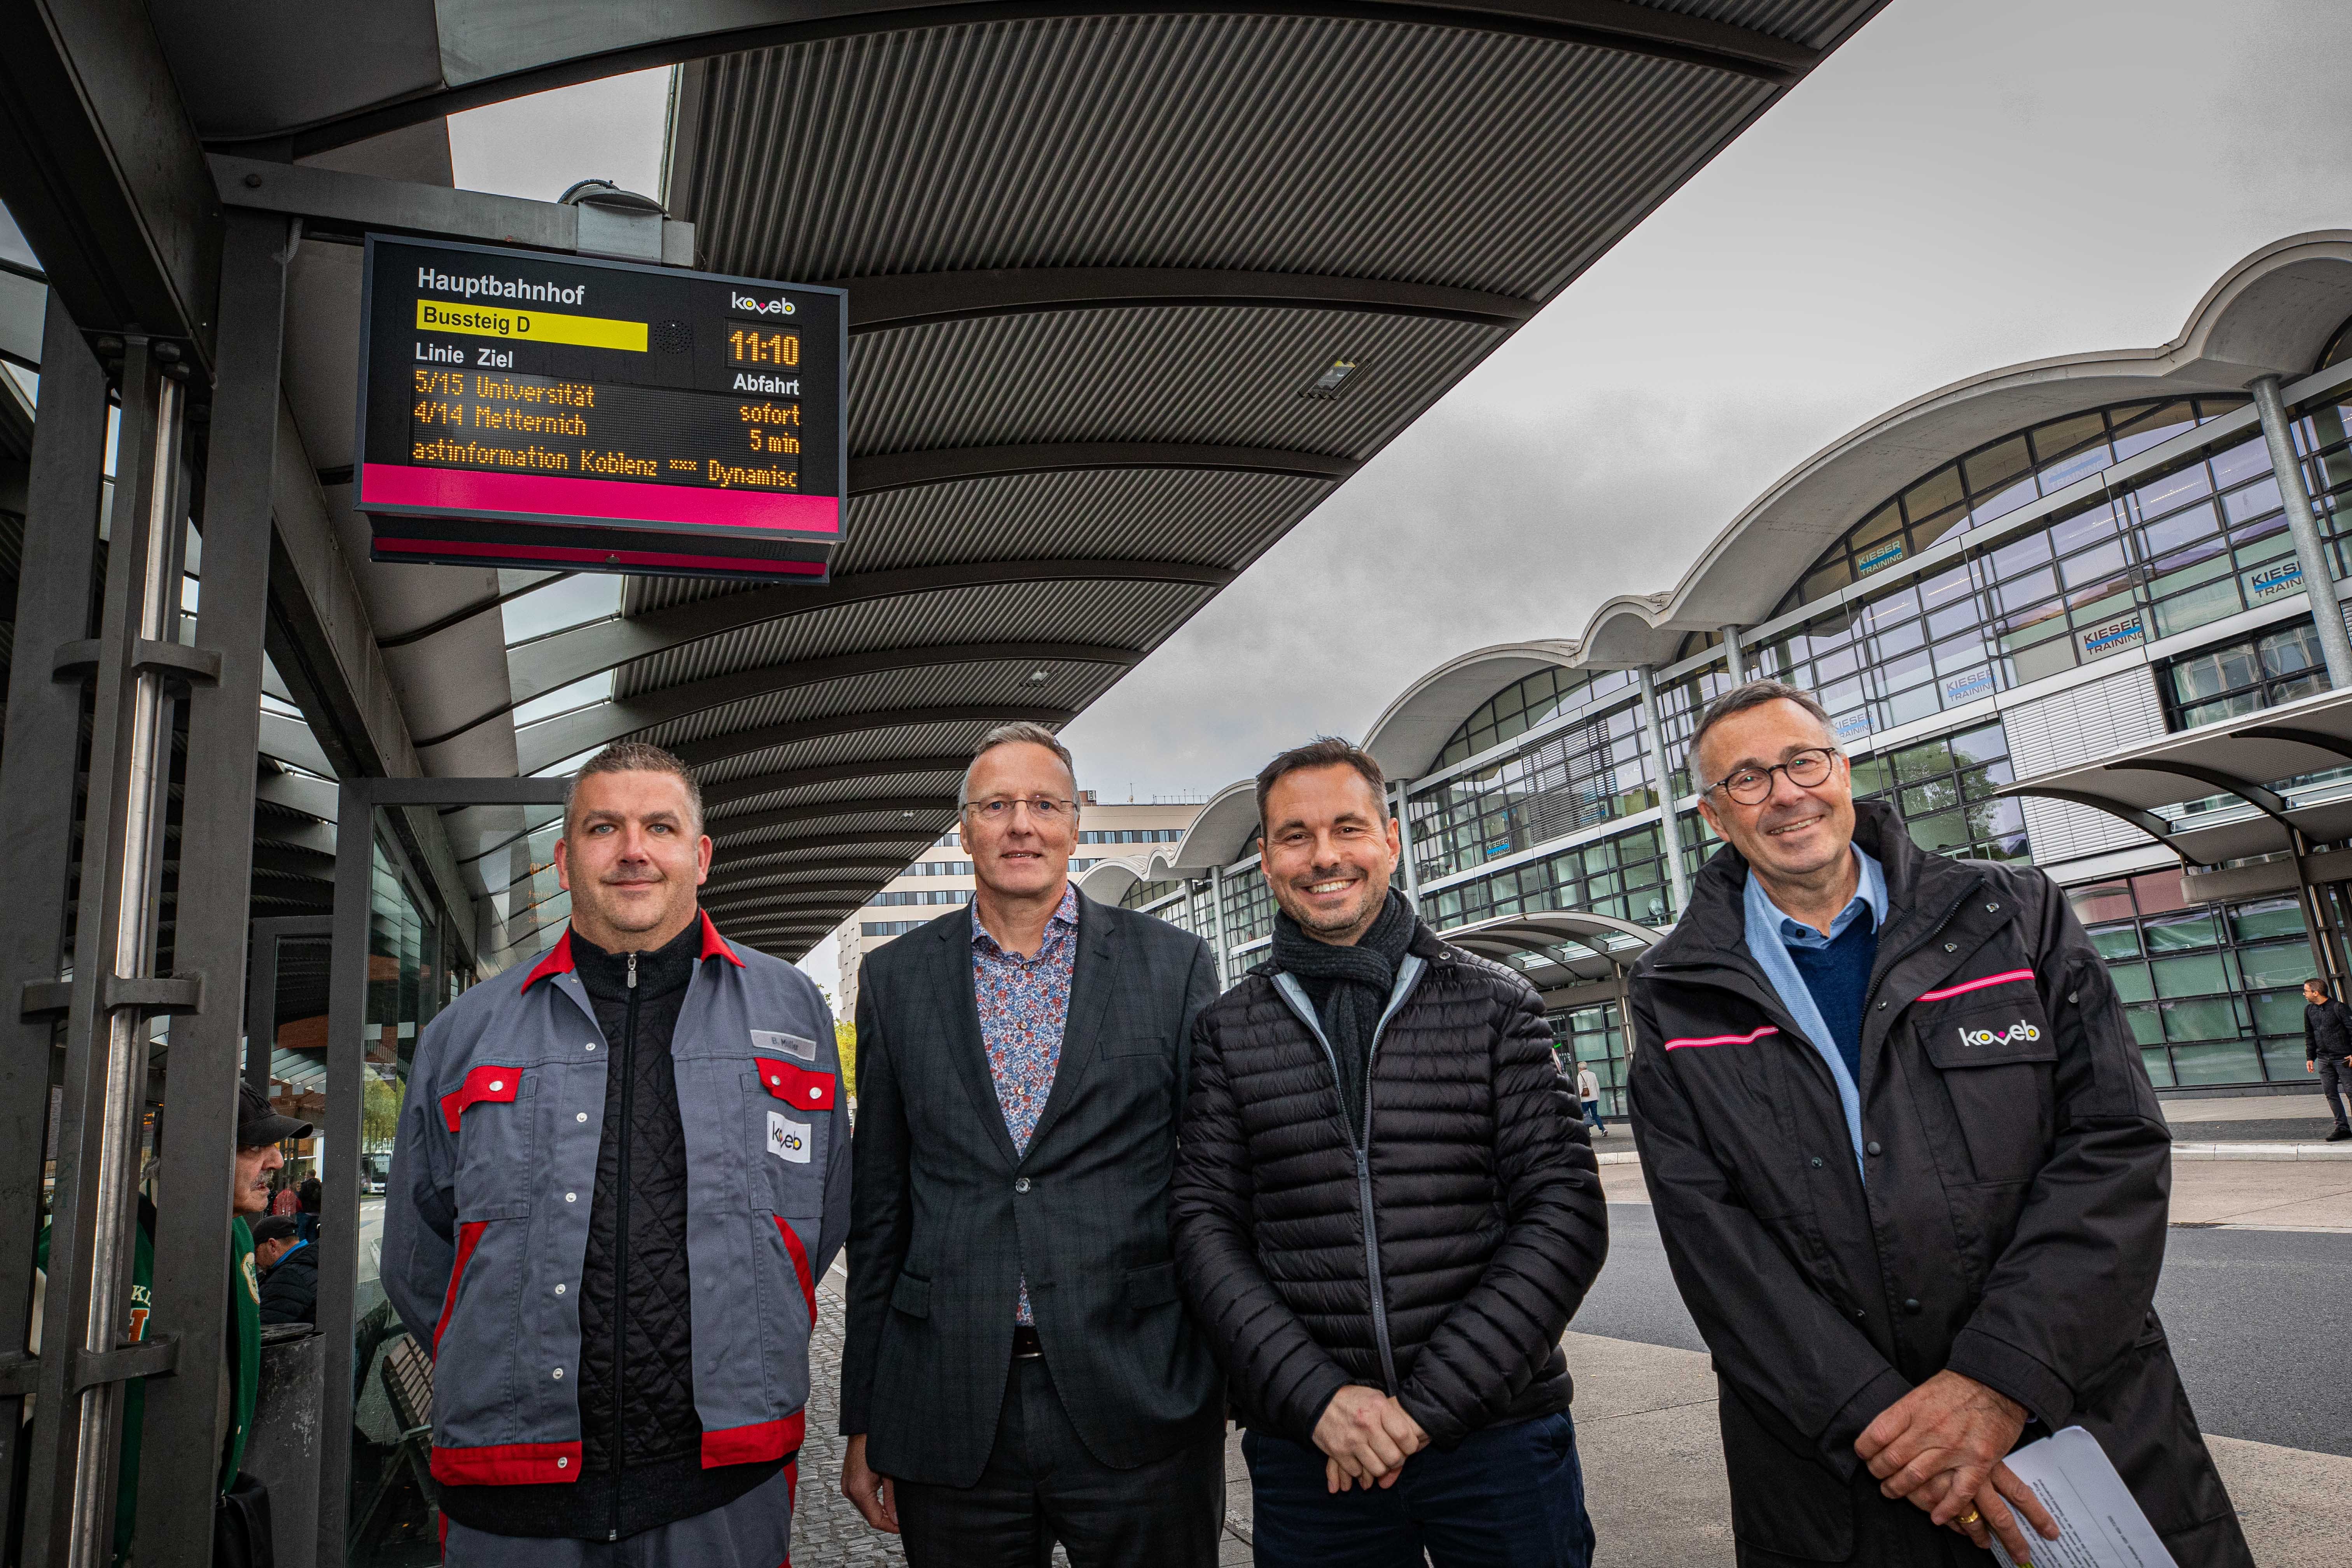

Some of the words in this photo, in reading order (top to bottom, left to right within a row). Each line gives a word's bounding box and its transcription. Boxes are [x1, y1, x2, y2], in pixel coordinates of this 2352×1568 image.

[418, 267, 585, 305] Hauptbahnhof
[731, 292, 796, 315] koveb
[423, 306, 509, 335] Bussteig
[518, 316, 530, 332] D
[416, 343, 464, 364] Linie
[477, 348, 513, 368] Ziel
[730, 330, 799, 365] 11:10
[733, 373, 799, 395] Abfahrt
[415, 370, 463, 395] 5/15
[476, 376, 595, 407] Universität
[740, 403, 800, 426] sofort
[414, 400, 463, 426] 4/14
[476, 406, 586, 435] Metternich
[750, 430, 761, 451] 5
[768, 432, 799, 454] min
[413, 439, 568, 469] astinformation
[581, 449, 658, 476] Koblenz
[708, 459, 797, 488] Dynamisc
[1858, 541, 1901, 566] KIESER
[1861, 552, 1903, 575] TRAINING
[2251, 561, 2301, 586] KIES
[1839, 723, 1875, 738] RAINING
[1486, 839, 1508, 851] KIESER
[1488, 847, 1509, 858] TRAINING
[1959, 1019, 2040, 1046] koveb
